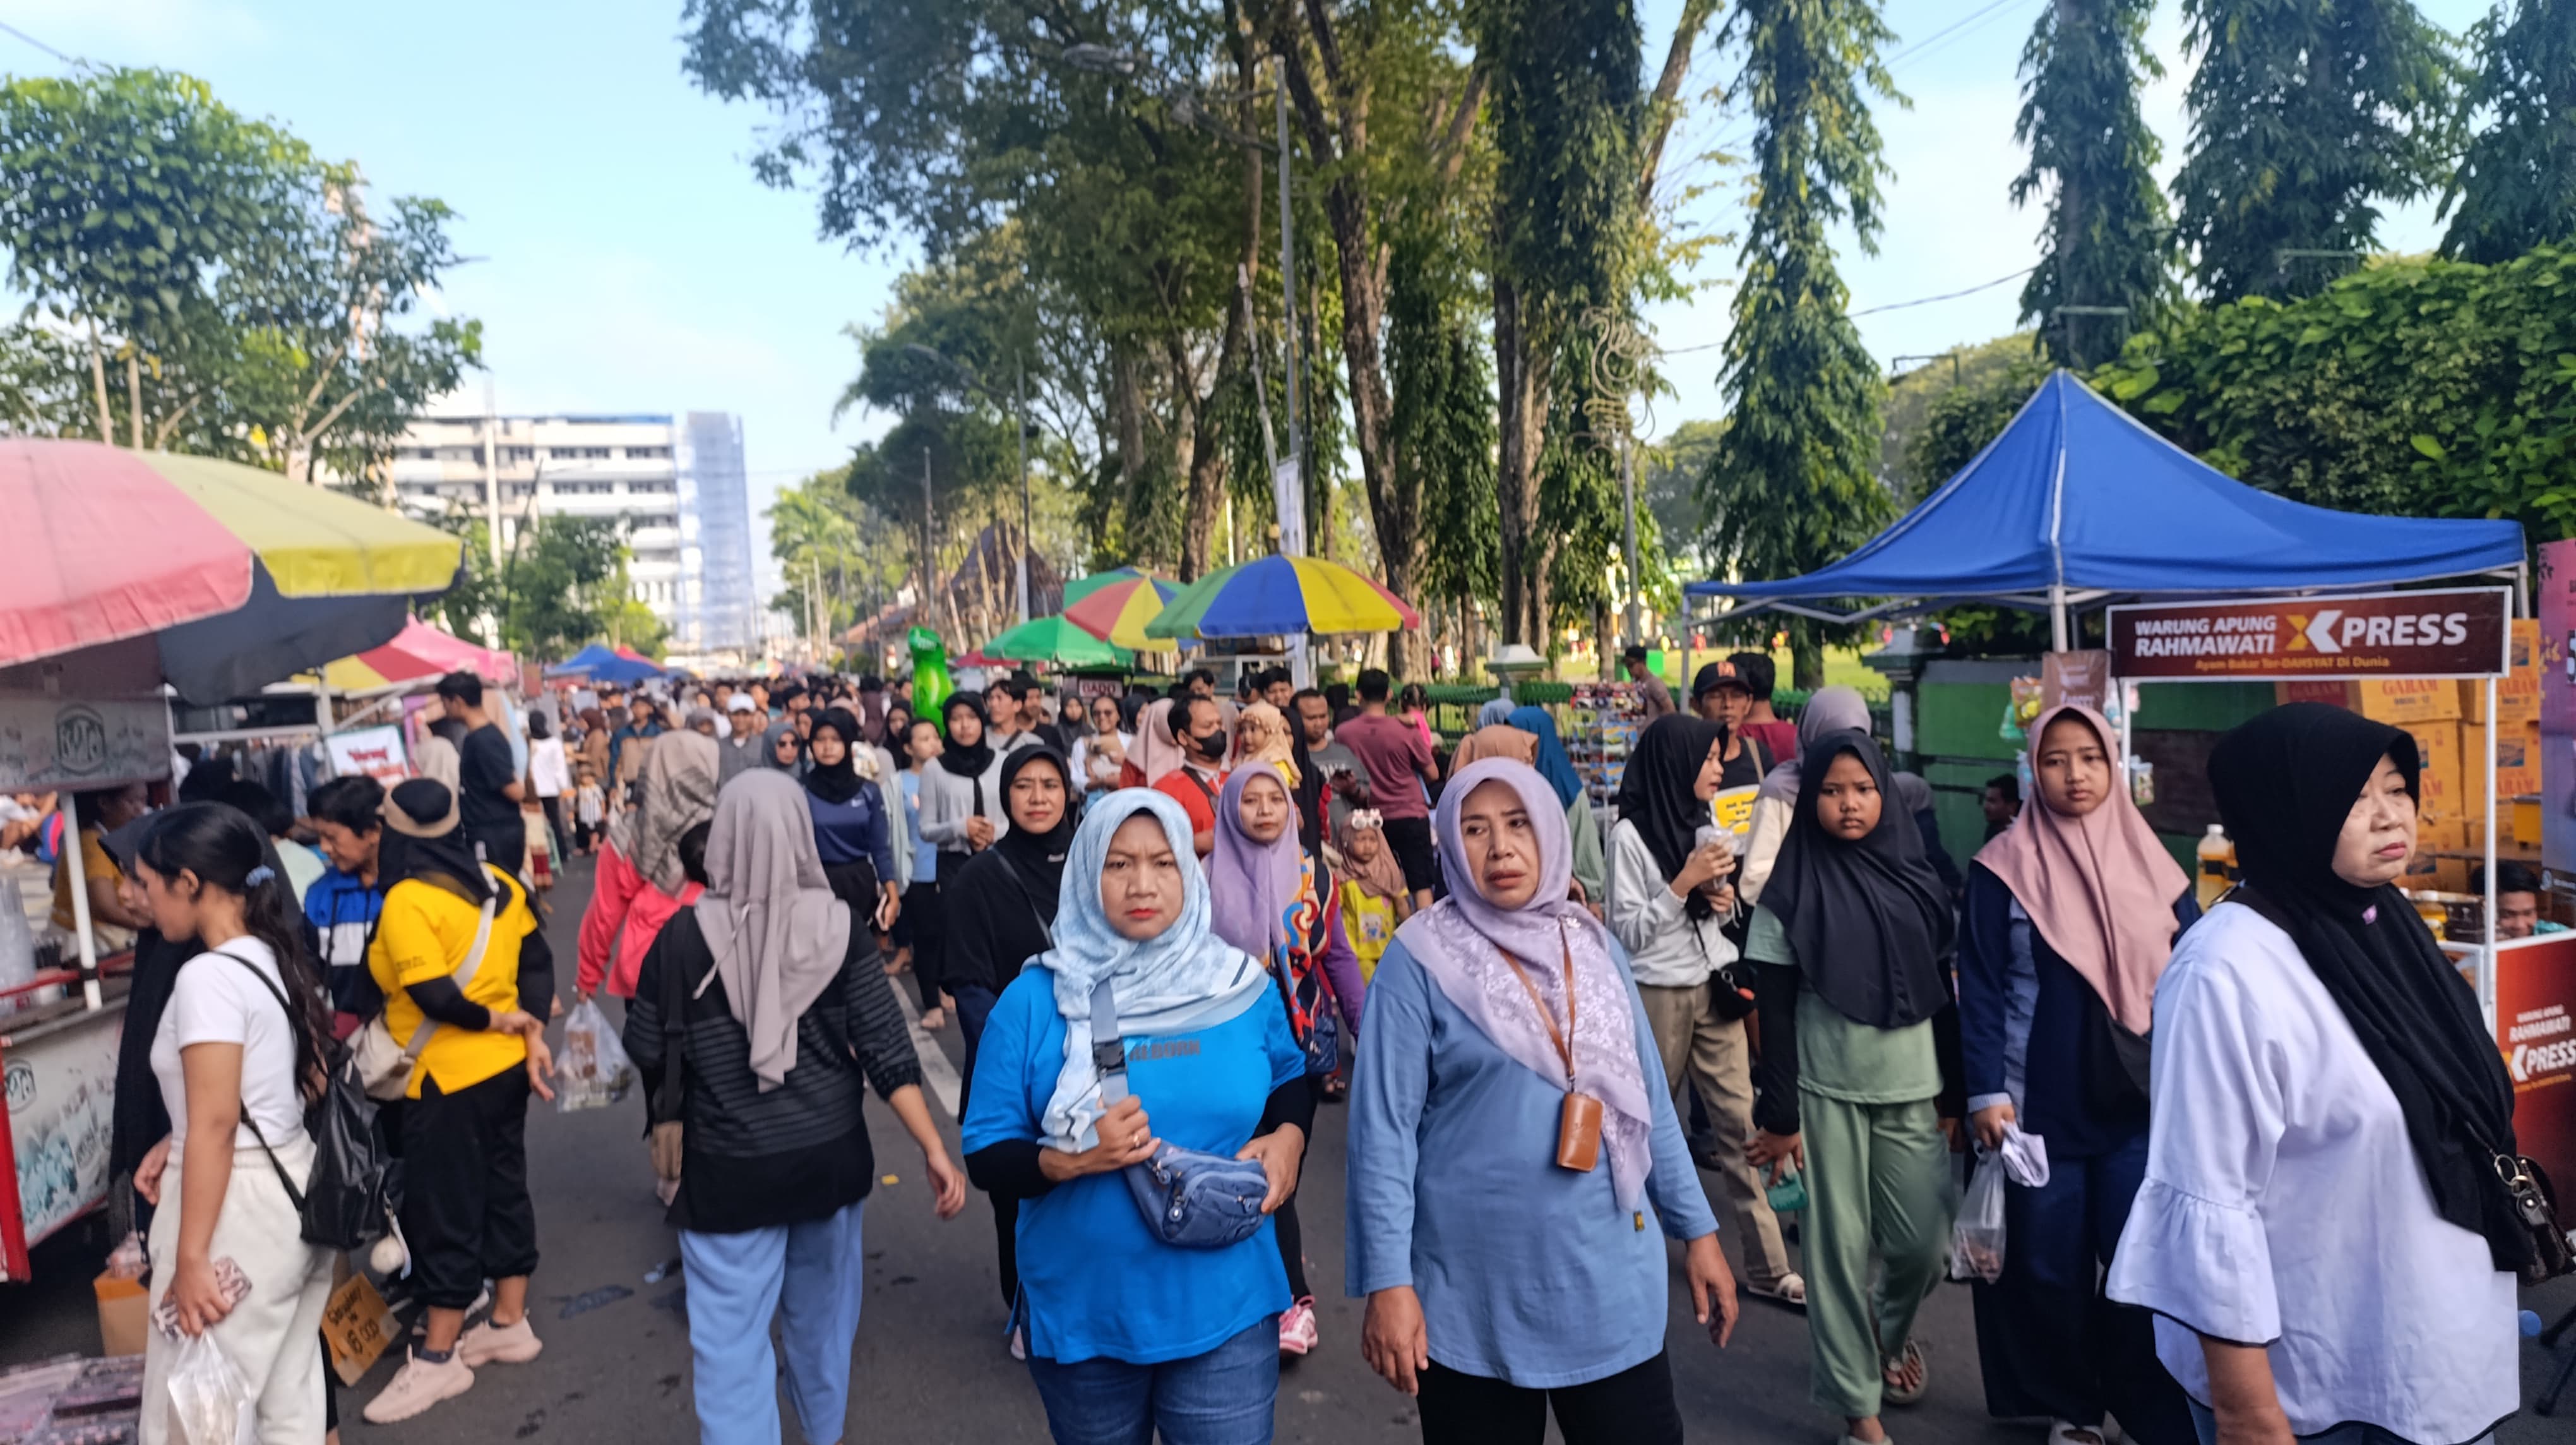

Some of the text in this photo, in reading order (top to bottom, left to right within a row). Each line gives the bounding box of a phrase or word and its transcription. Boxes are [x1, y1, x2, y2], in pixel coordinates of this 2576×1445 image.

[2135, 616, 2277, 636] WARUNG APUNG
[2286, 610, 2467, 653] XPRESS
[2135, 634, 2275, 657] RAHMAWATI
[2337, 657, 2350, 668] Di
[2352, 656, 2390, 668] Dunia
